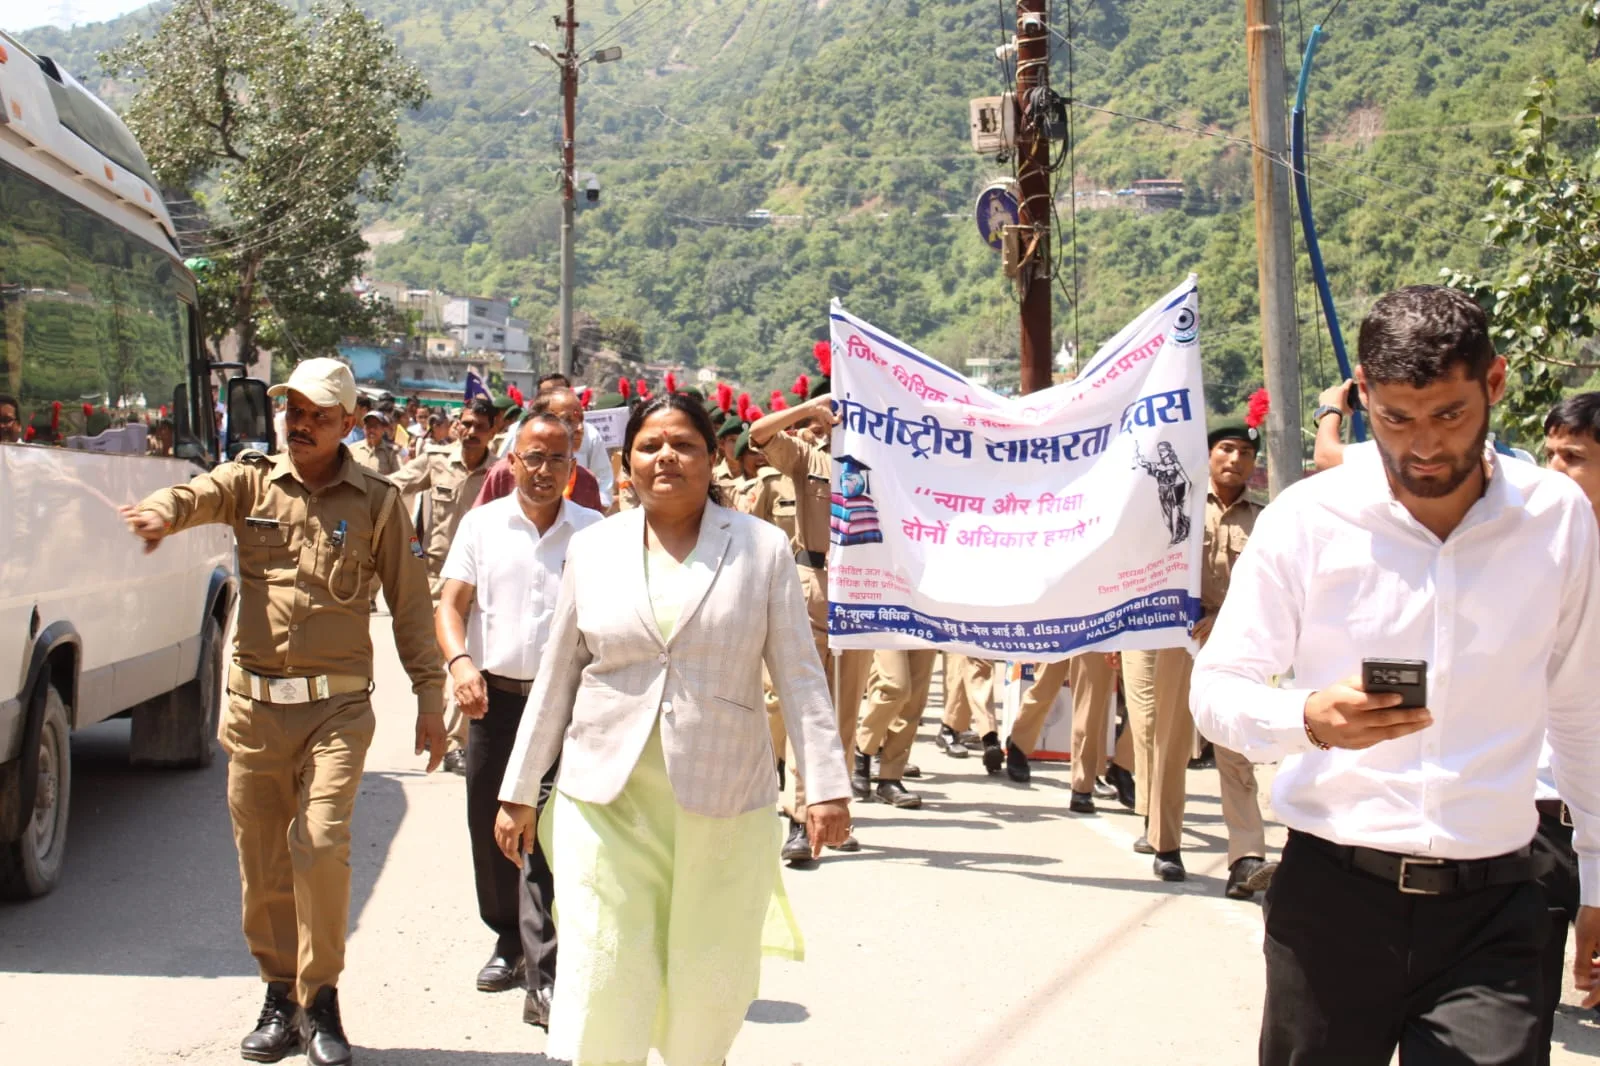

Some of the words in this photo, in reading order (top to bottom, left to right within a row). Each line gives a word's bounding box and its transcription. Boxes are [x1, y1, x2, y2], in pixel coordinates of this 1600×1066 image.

[984, 423, 1113, 464] साक्षरता
[992, 492, 1033, 515] और
[1038, 492, 1085, 515] शिक्षा
[901, 516, 951, 545] दोनों
[956, 525, 1039, 548] अधिकार
[878, 607, 911, 621] विधिक
[1086, 620, 1126, 640] NALSA
[1127, 611, 1177, 627] Helpline
